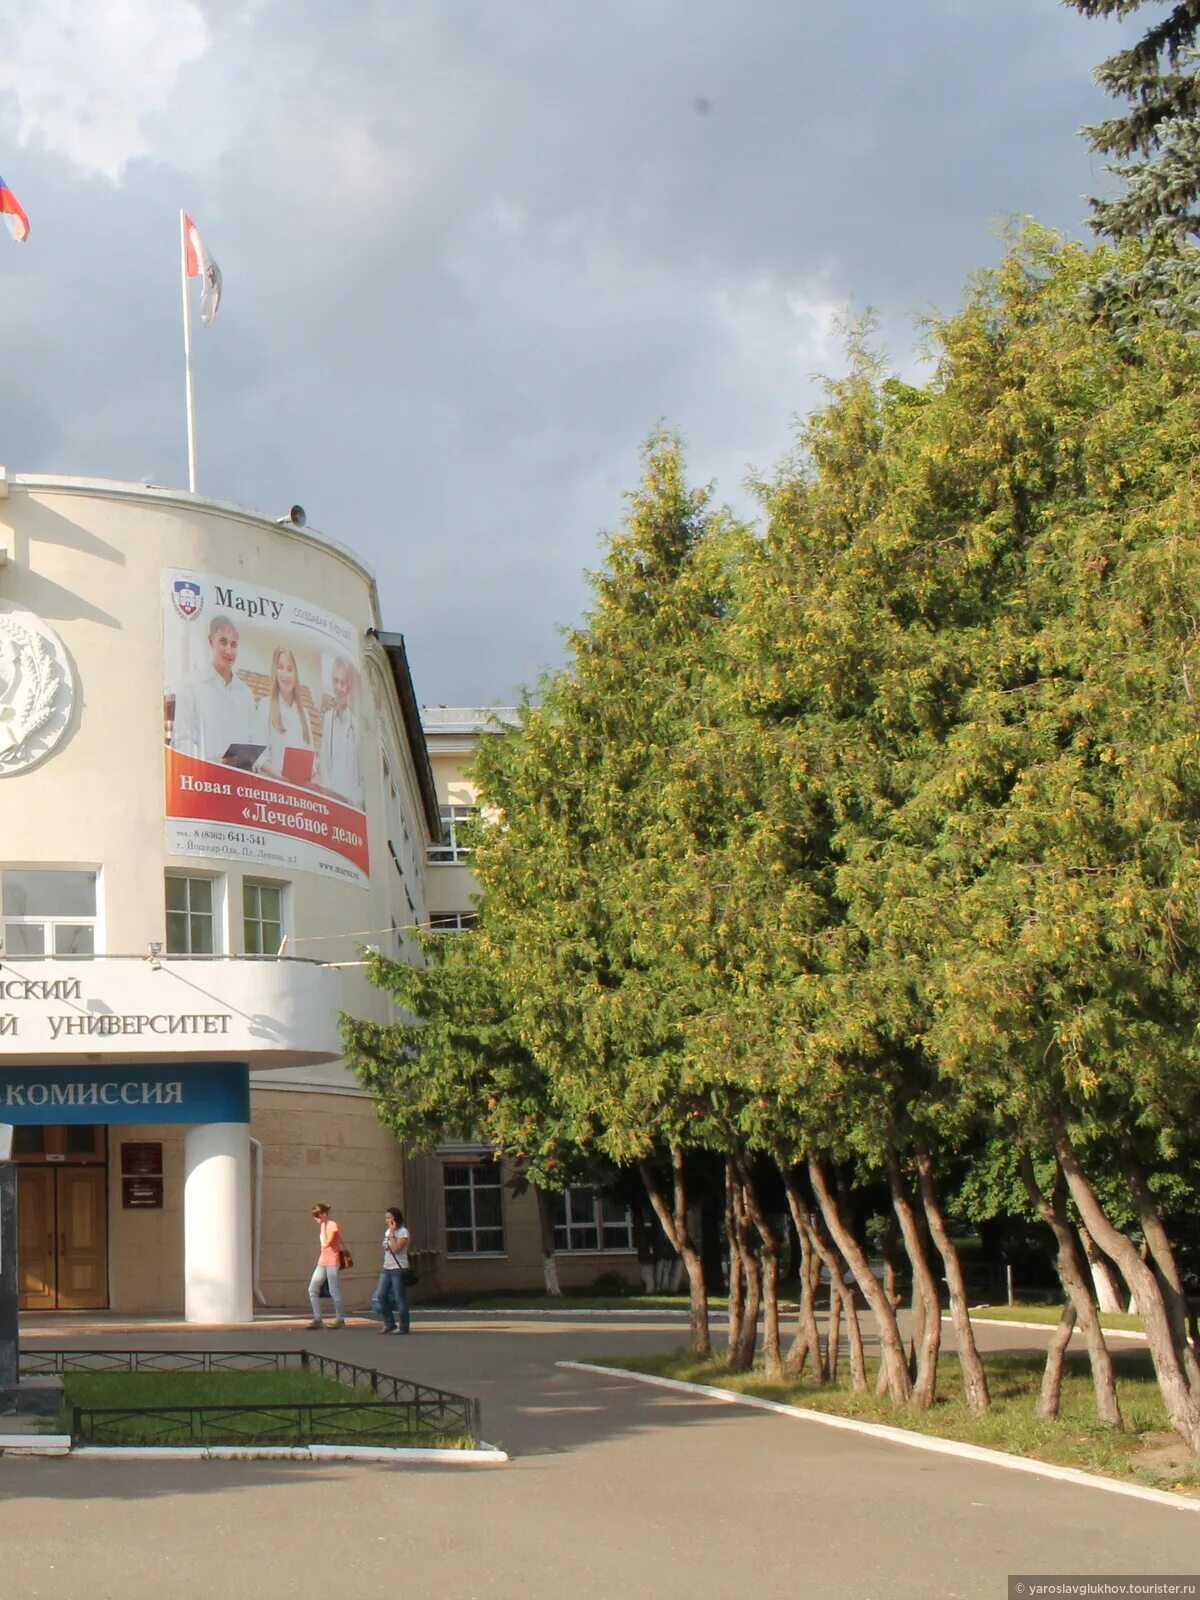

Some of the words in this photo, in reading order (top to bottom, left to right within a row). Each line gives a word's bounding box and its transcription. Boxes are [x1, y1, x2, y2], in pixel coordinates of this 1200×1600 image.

[214, 586, 284, 620] МарГУ
[179, 774, 231, 796] Новая
[236, 785, 330, 816] специальность
[194, 829, 200, 838] 8
[201, 830, 226, 842] (8362)
[227, 831, 266, 846] 641-541
[242, 802, 328, 837] «Лечебное
[331, 826, 364, 848] дело»
[48, 1013, 232, 1040] УНИВЕРСИТЕТ
[6, 1082, 184, 1106] КОМИССИЯ
